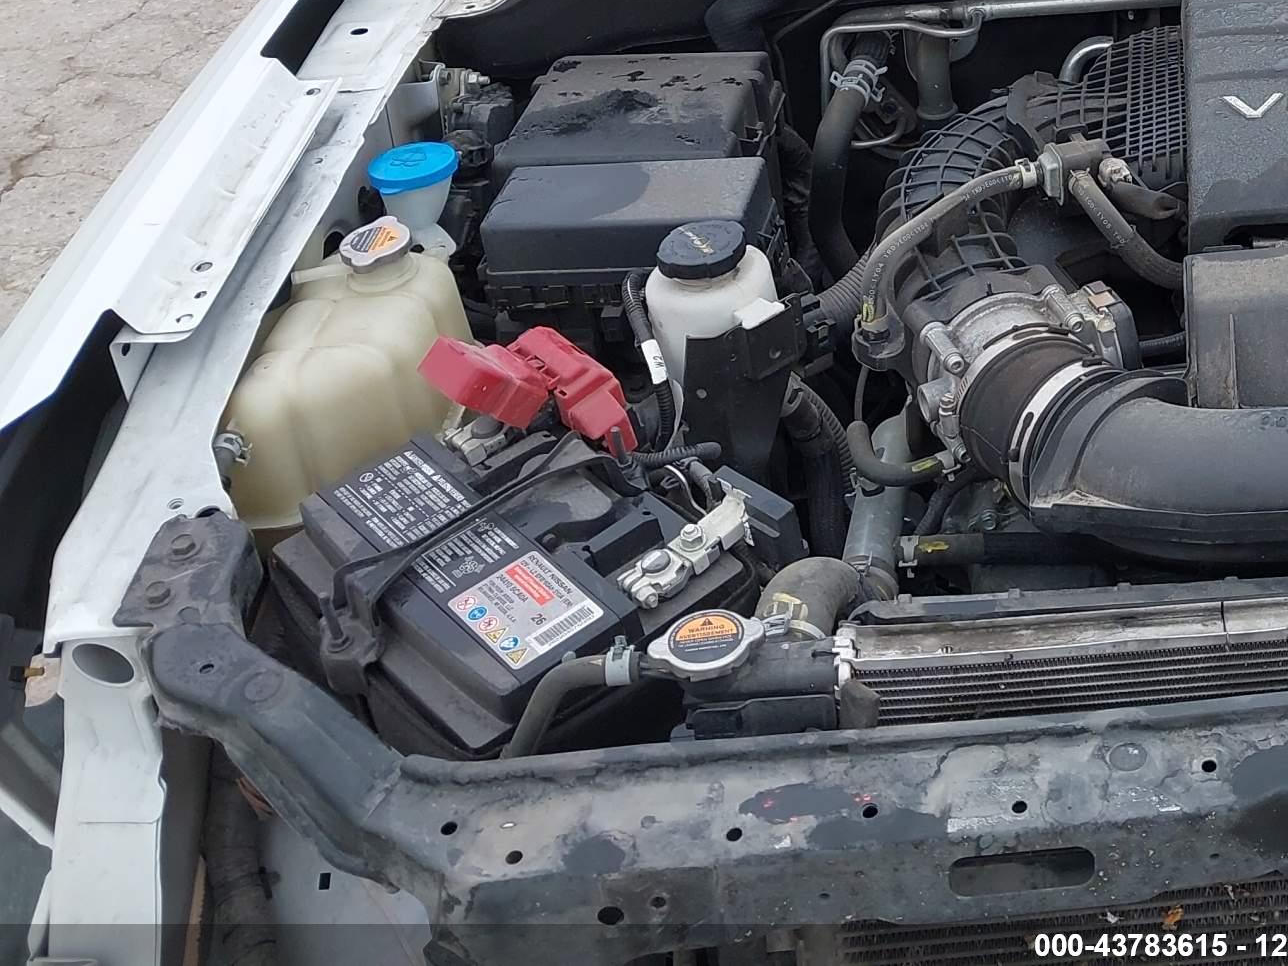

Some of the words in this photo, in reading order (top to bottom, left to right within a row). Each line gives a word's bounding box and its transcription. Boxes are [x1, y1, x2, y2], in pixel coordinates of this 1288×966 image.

[652, 355, 665, 369] W2
[528, 554, 551, 576] RENAULT
[550, 573, 573, 595] NISSAN
[531, 613, 547, 626] 26
[688, 624, 725, 634] WARNING
